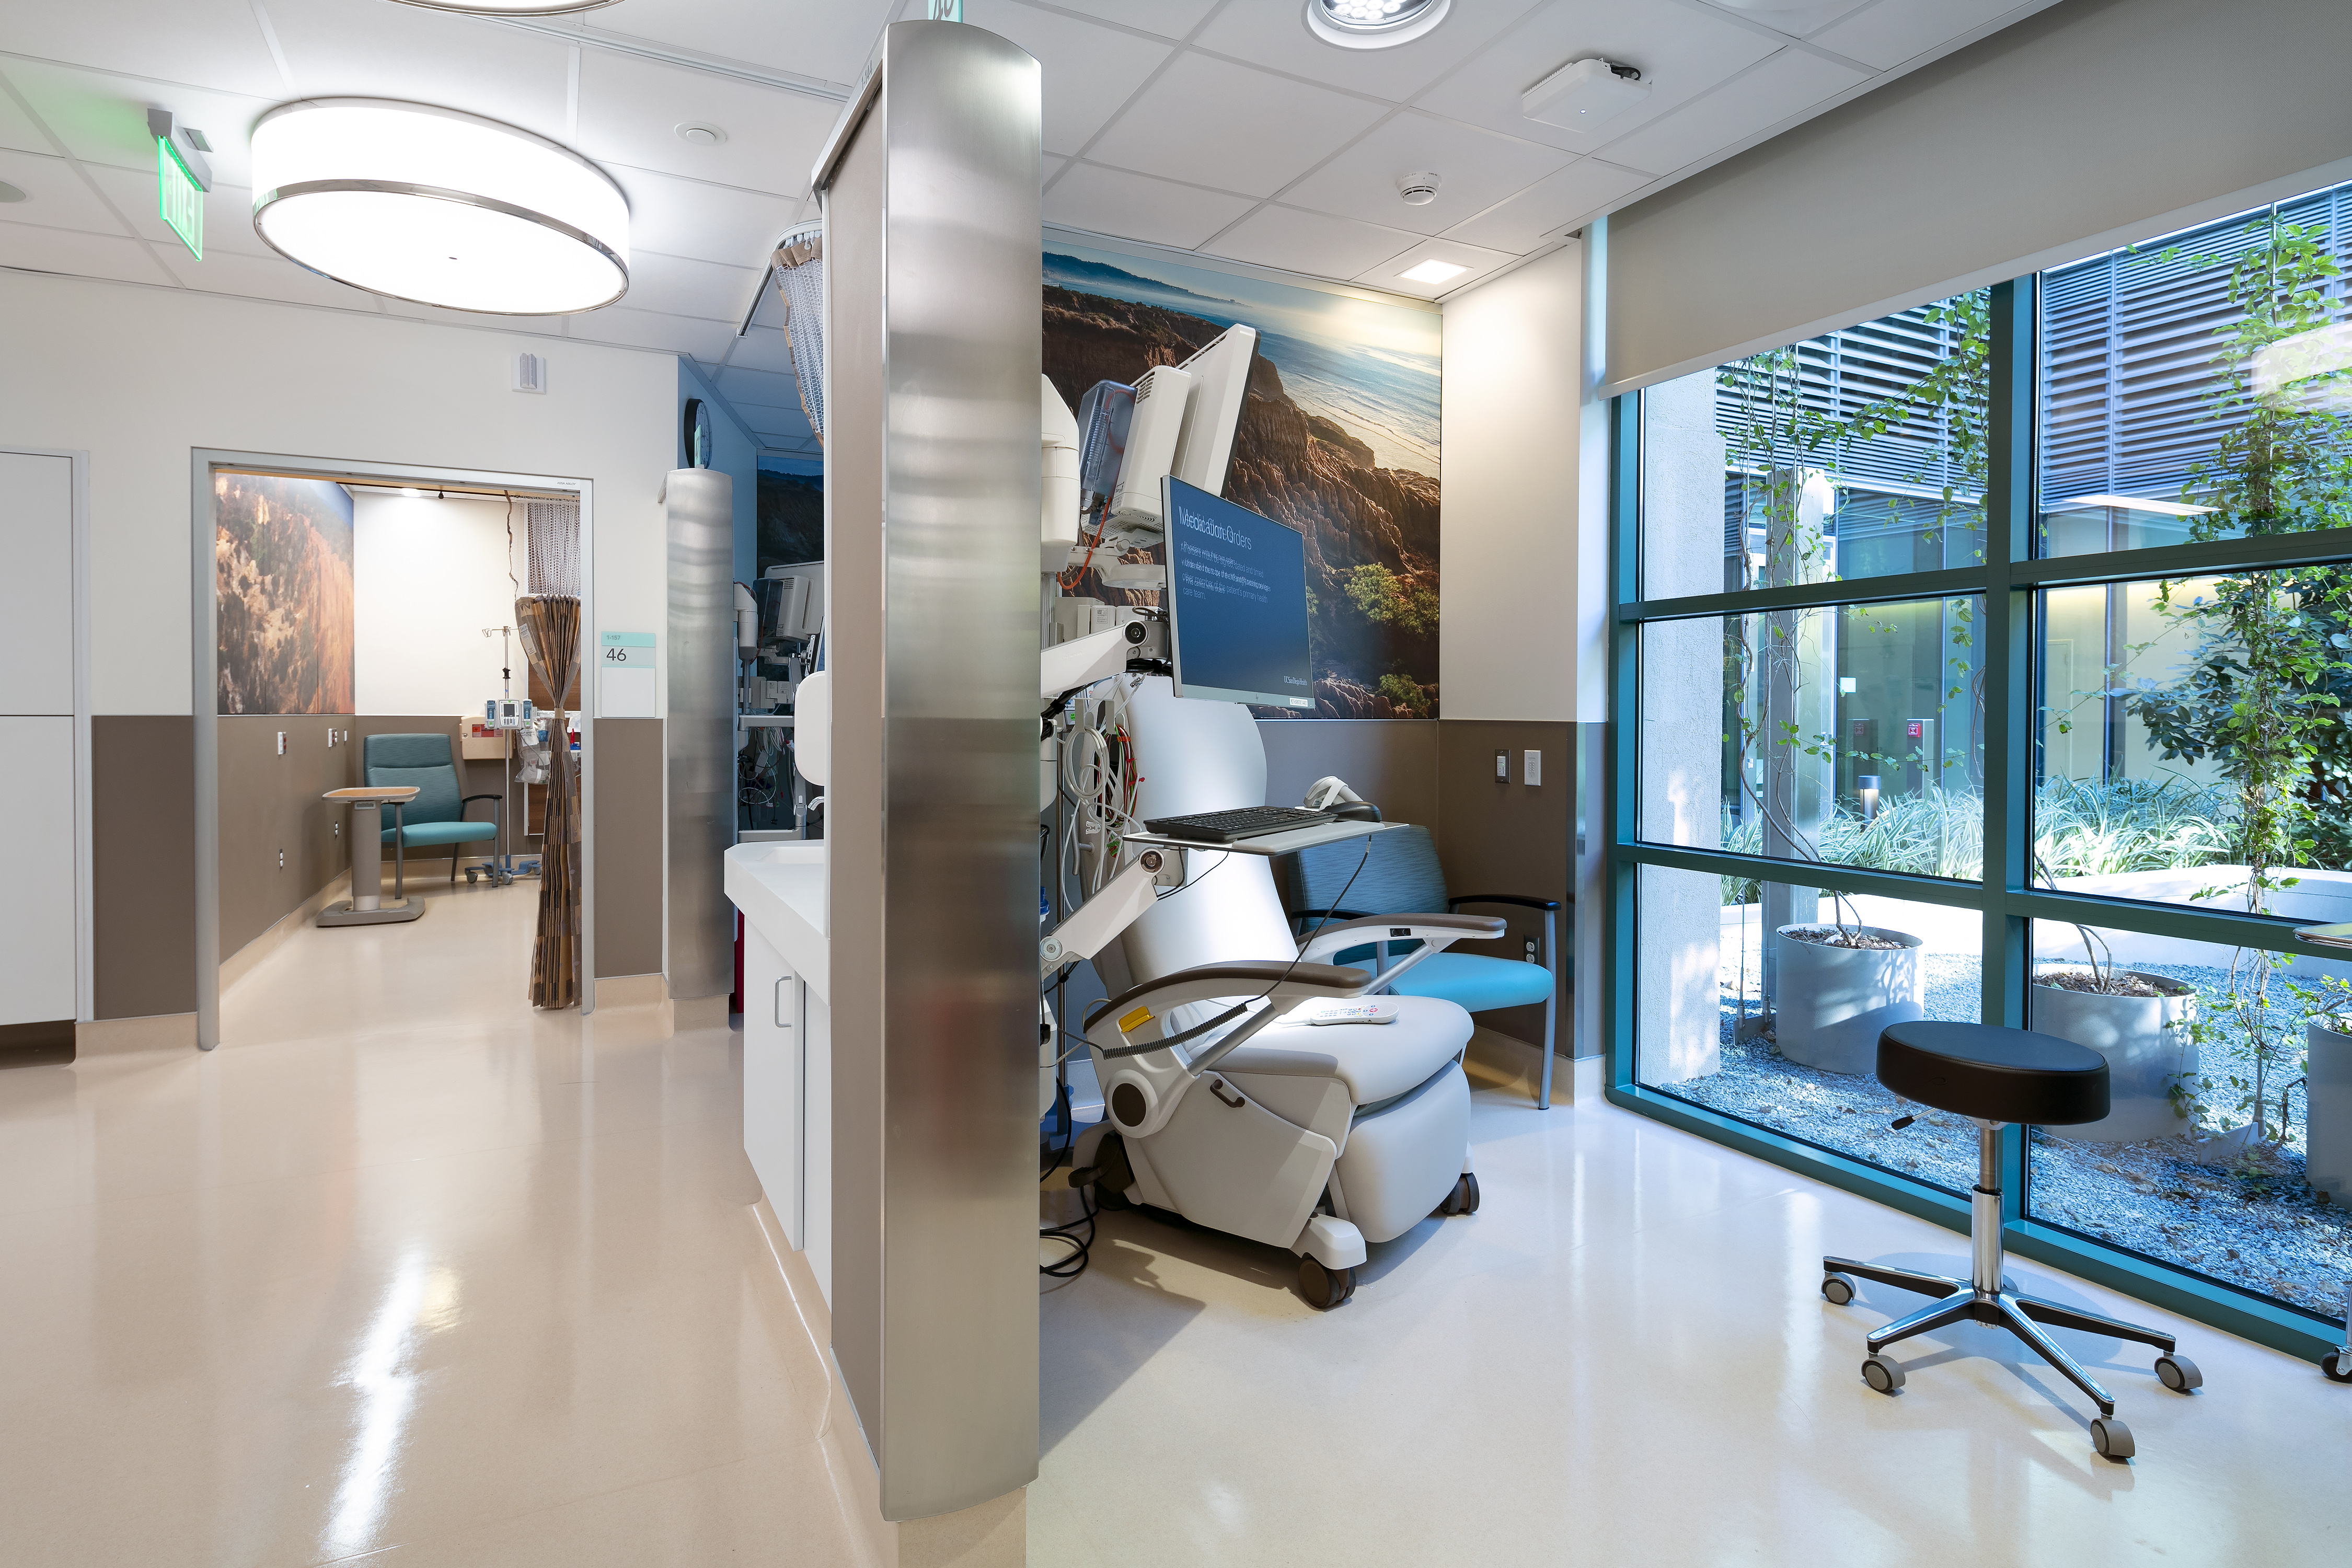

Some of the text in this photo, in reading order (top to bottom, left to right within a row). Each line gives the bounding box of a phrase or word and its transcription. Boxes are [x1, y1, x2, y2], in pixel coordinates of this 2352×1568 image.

[861, 60, 873, 91] 1-144
[1227, 525, 1252, 550] Orders
[1183, 587, 1193, 596] care
[606, 648, 627, 661] 46
